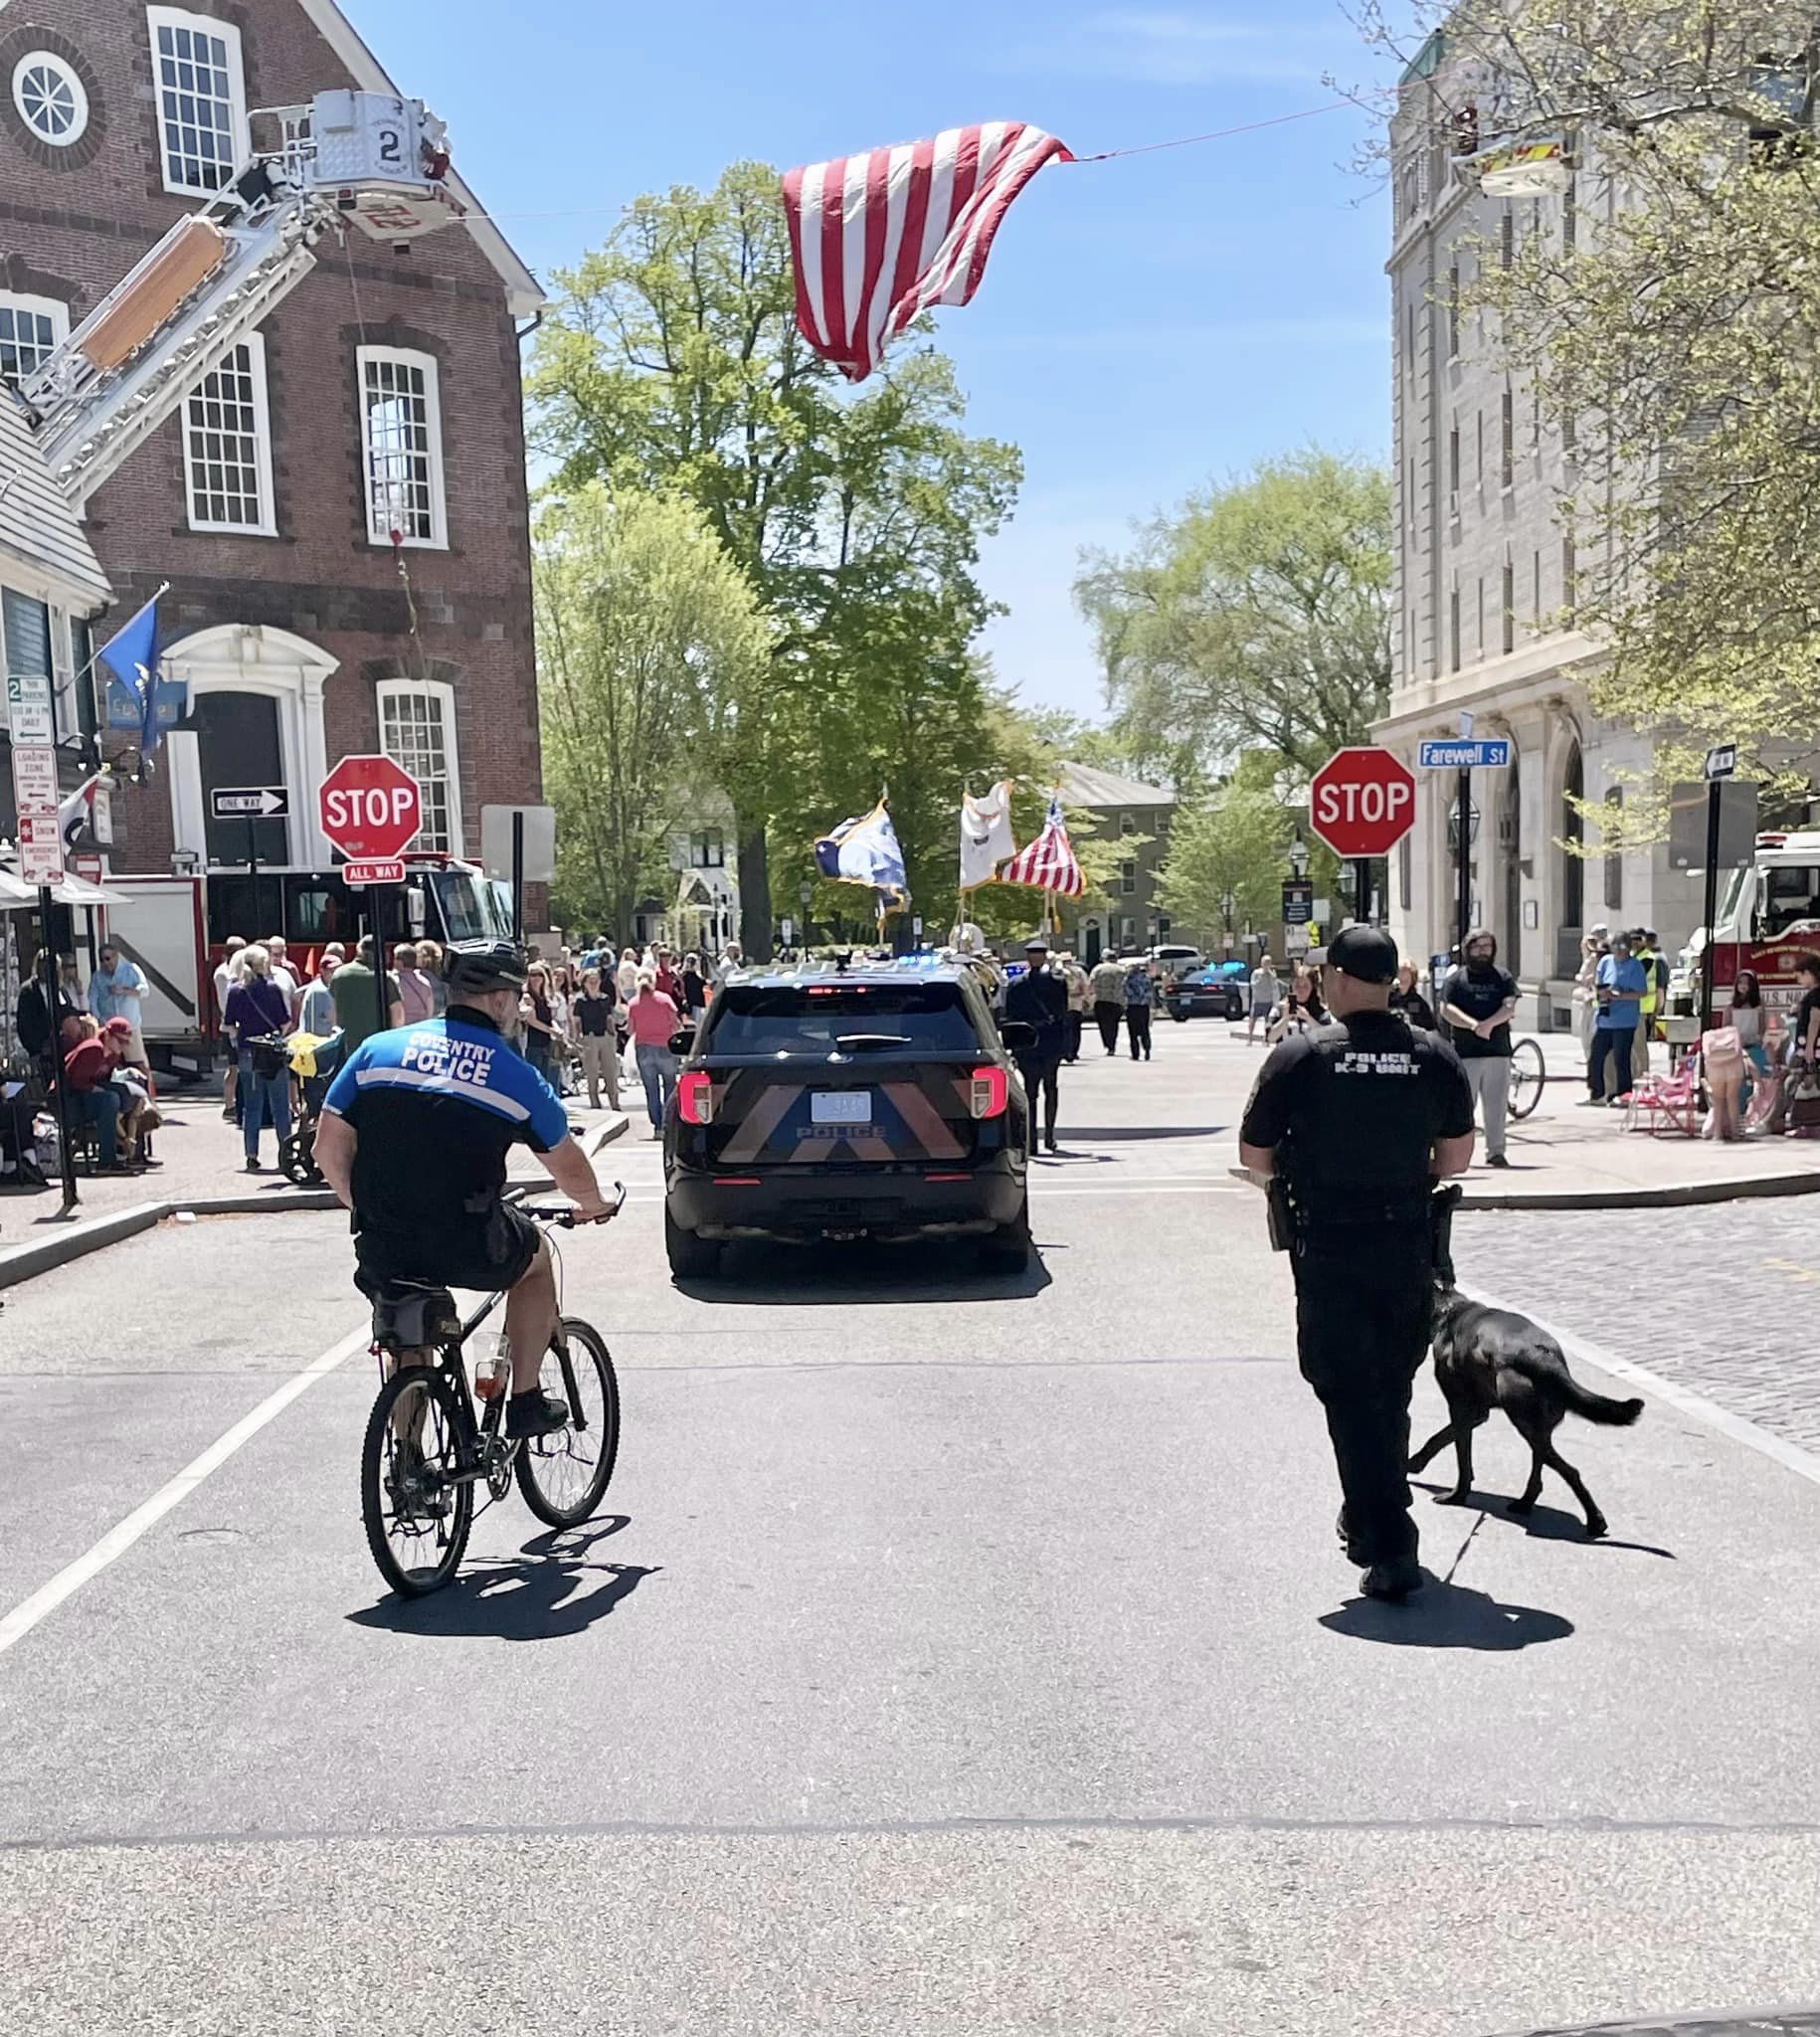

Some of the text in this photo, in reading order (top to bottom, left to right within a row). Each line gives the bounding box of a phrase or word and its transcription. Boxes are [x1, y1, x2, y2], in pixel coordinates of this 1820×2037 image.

[380, 130, 400, 161] 2
[9, 680, 20, 698] 2
[1422, 744, 1505, 765] Farewell St
[221, 798, 261, 809] ONE WAY
[326, 788, 414, 828] STOP
[1318, 782, 1410, 824] STOP
[349, 865, 399, 879] ALL WAY
[401, 1045, 491, 1086] POLICE
[1344, 1052, 1411, 1064] POLICE
[1375, 1063, 1421, 1075] UNIT
[797, 1125, 885, 1139] POLICE
